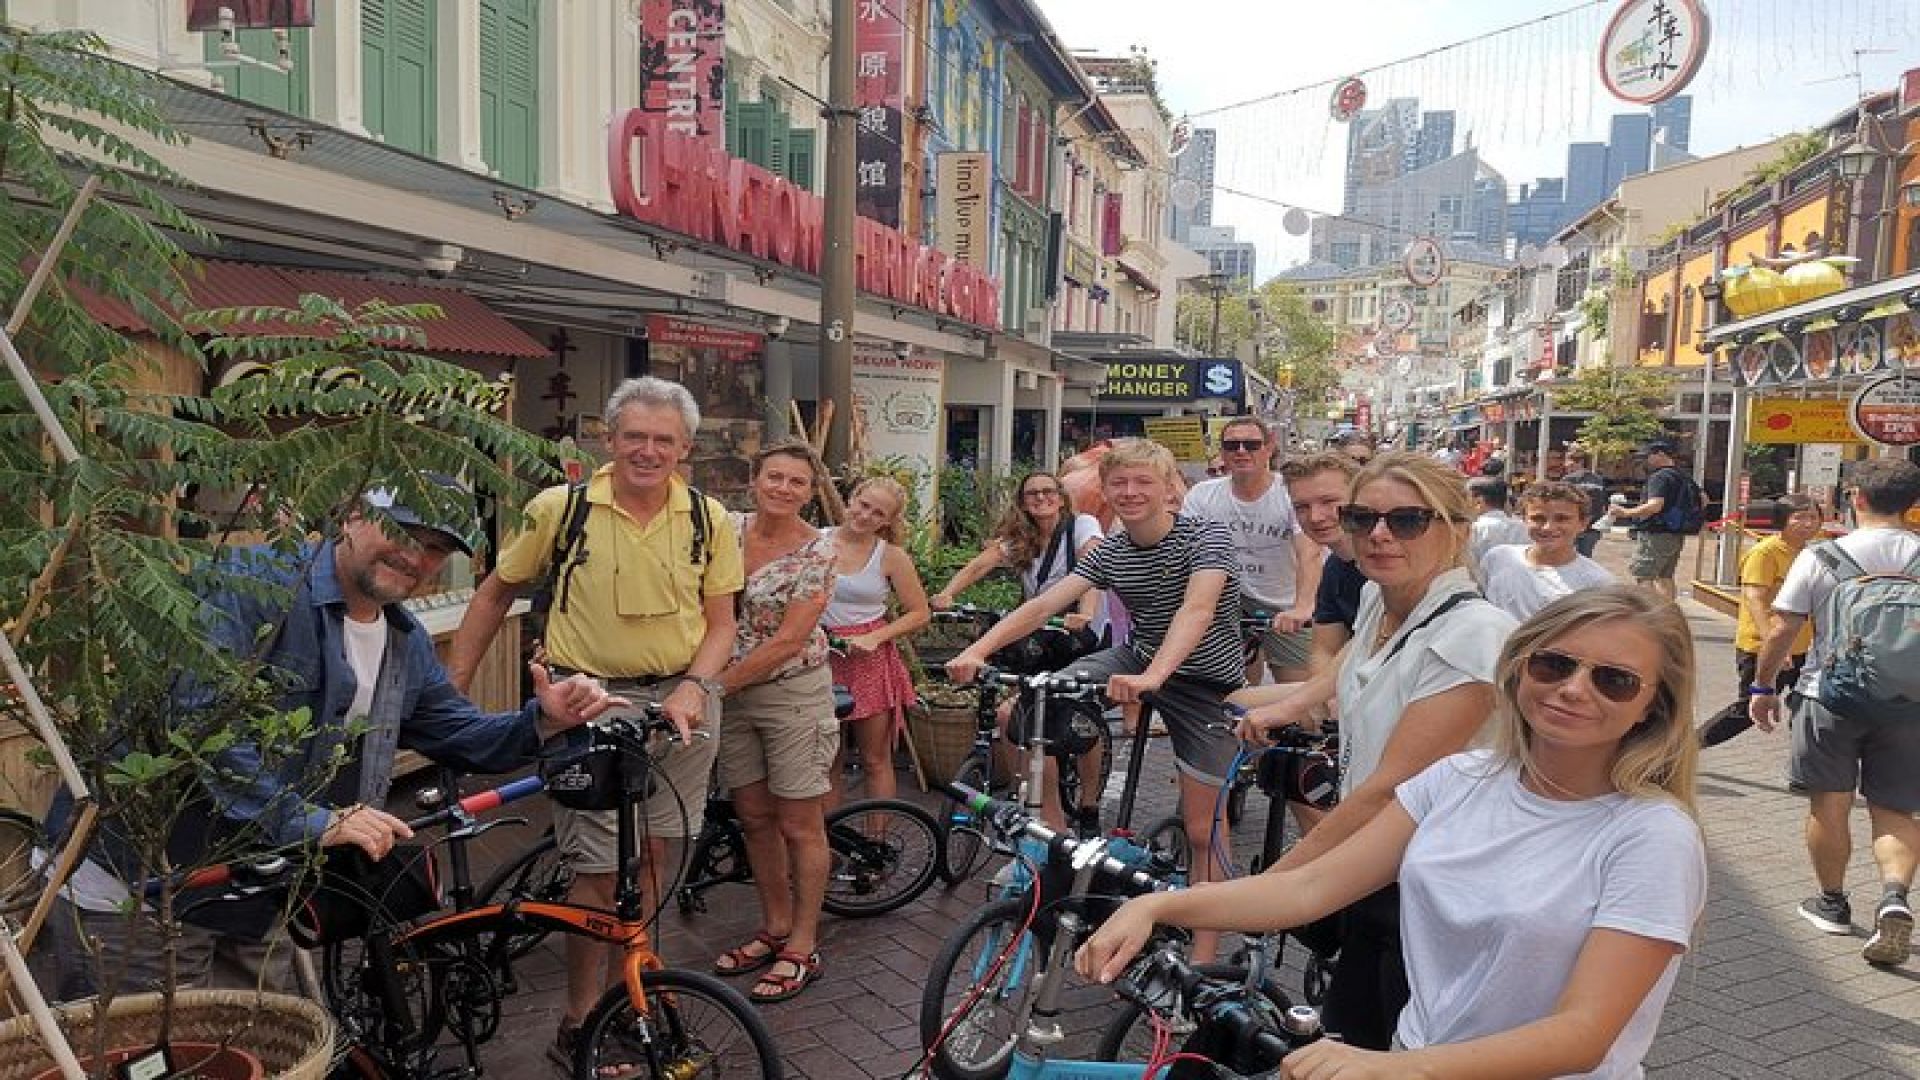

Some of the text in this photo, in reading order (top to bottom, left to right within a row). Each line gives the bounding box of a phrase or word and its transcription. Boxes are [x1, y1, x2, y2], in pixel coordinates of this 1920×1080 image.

[665, 9, 697, 137] CENTRE
[852, 355, 897, 368] SEUM
[1106, 363, 1186, 379] MONEY
